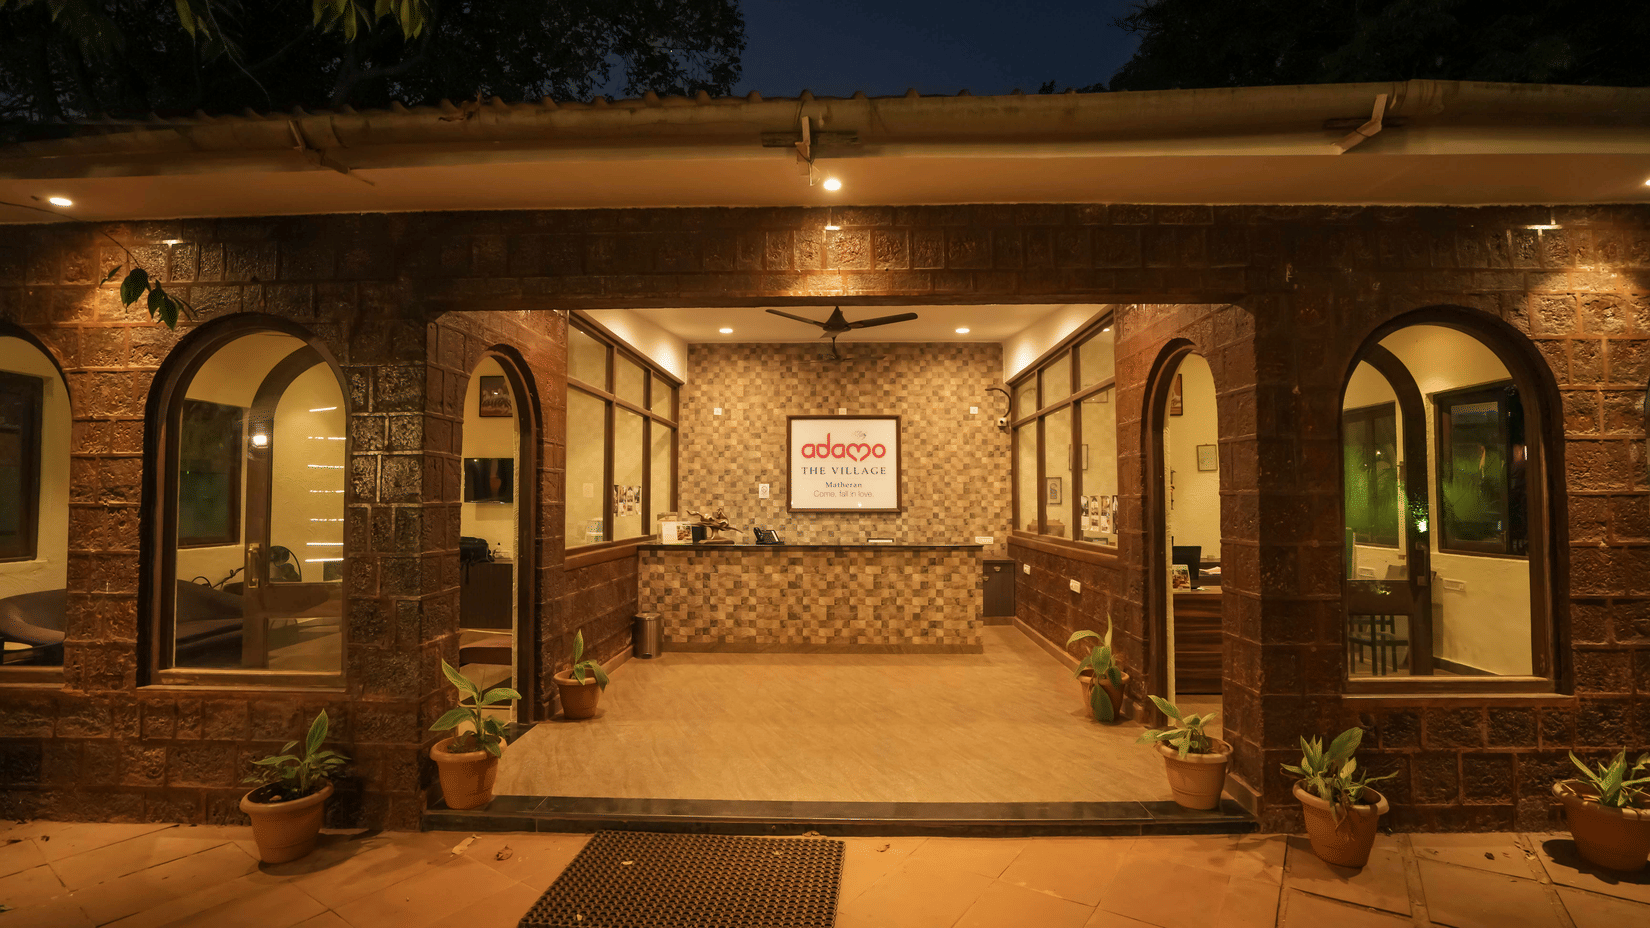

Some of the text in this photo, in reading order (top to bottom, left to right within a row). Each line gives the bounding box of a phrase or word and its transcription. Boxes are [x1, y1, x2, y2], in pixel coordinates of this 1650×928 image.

[801, 466, 886, 474] THE VILLAGE
[839, 490, 848, 498] fall
[851, 490, 856, 498] in
